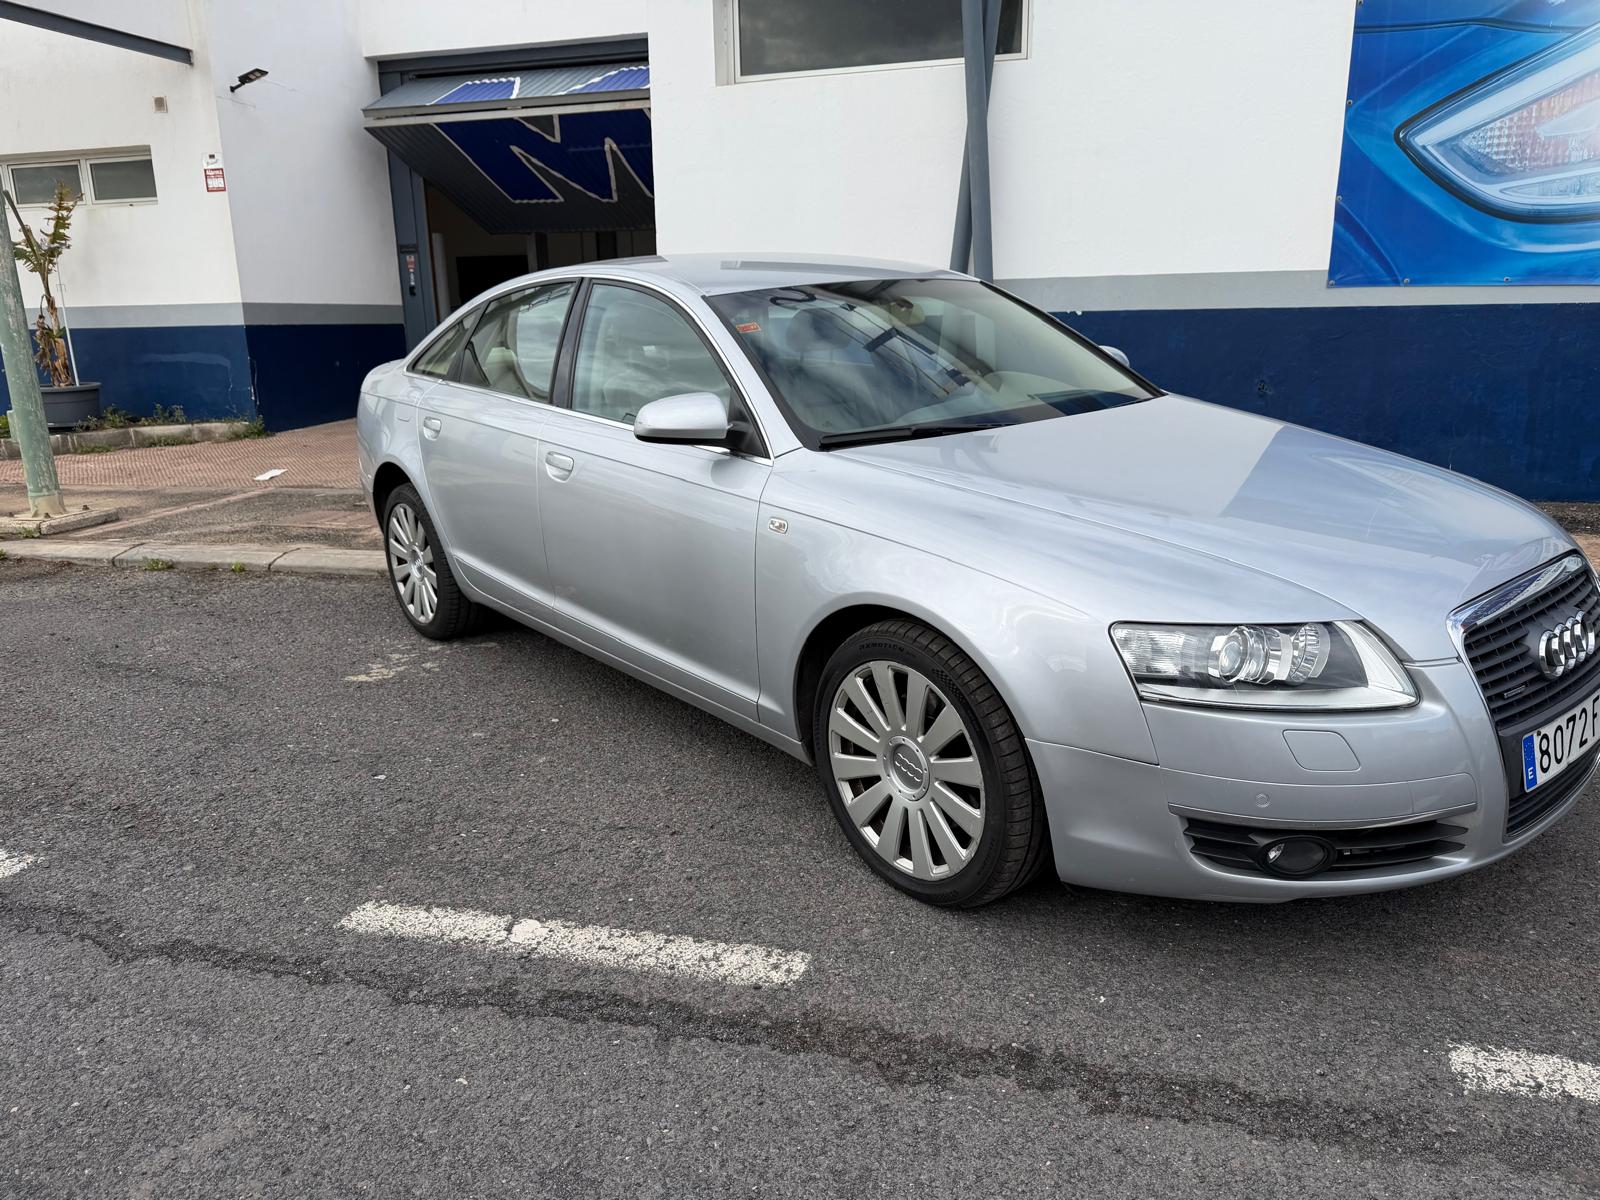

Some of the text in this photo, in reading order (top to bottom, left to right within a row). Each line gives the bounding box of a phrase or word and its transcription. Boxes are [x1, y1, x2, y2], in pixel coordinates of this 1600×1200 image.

[1538, 694, 1599, 774] 8072 F
[1528, 767, 1534, 780] E
